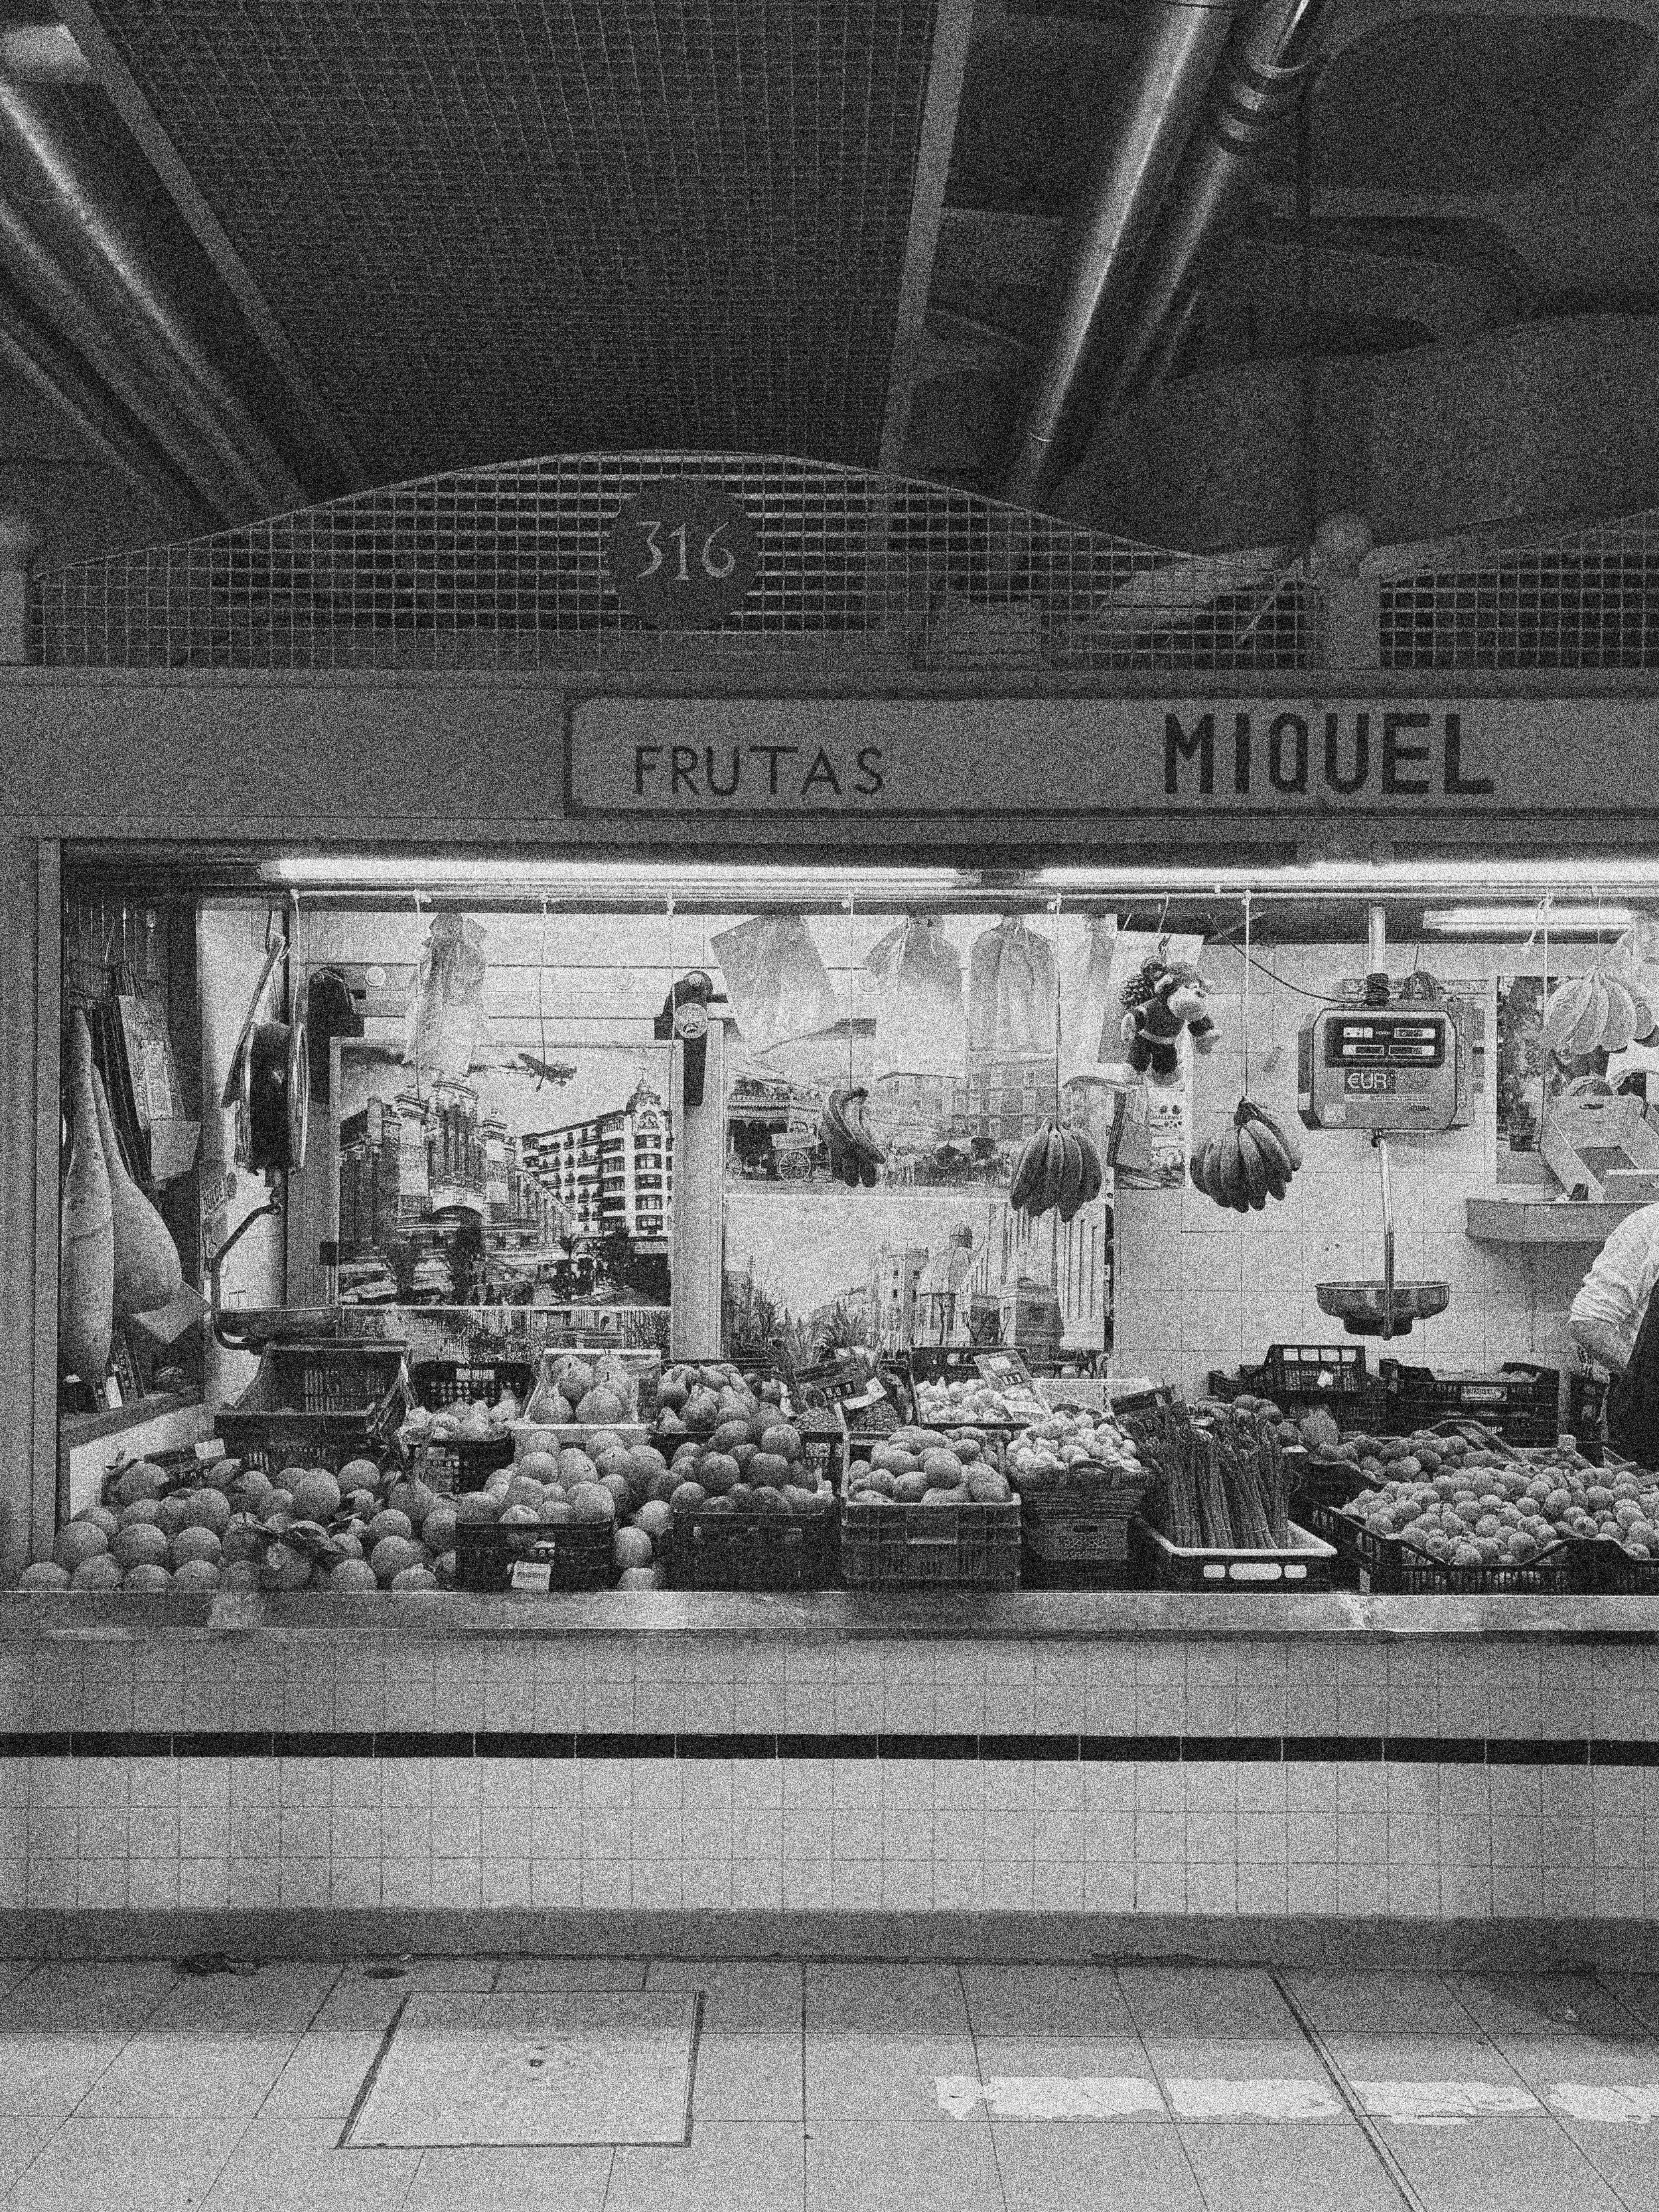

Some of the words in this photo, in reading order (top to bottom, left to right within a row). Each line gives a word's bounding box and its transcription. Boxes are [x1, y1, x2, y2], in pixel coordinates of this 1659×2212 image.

[635, 520, 737, 581] 316
[633, 745, 886, 796] FRUTAS
[1163, 712, 1495, 795] MIQUEL
